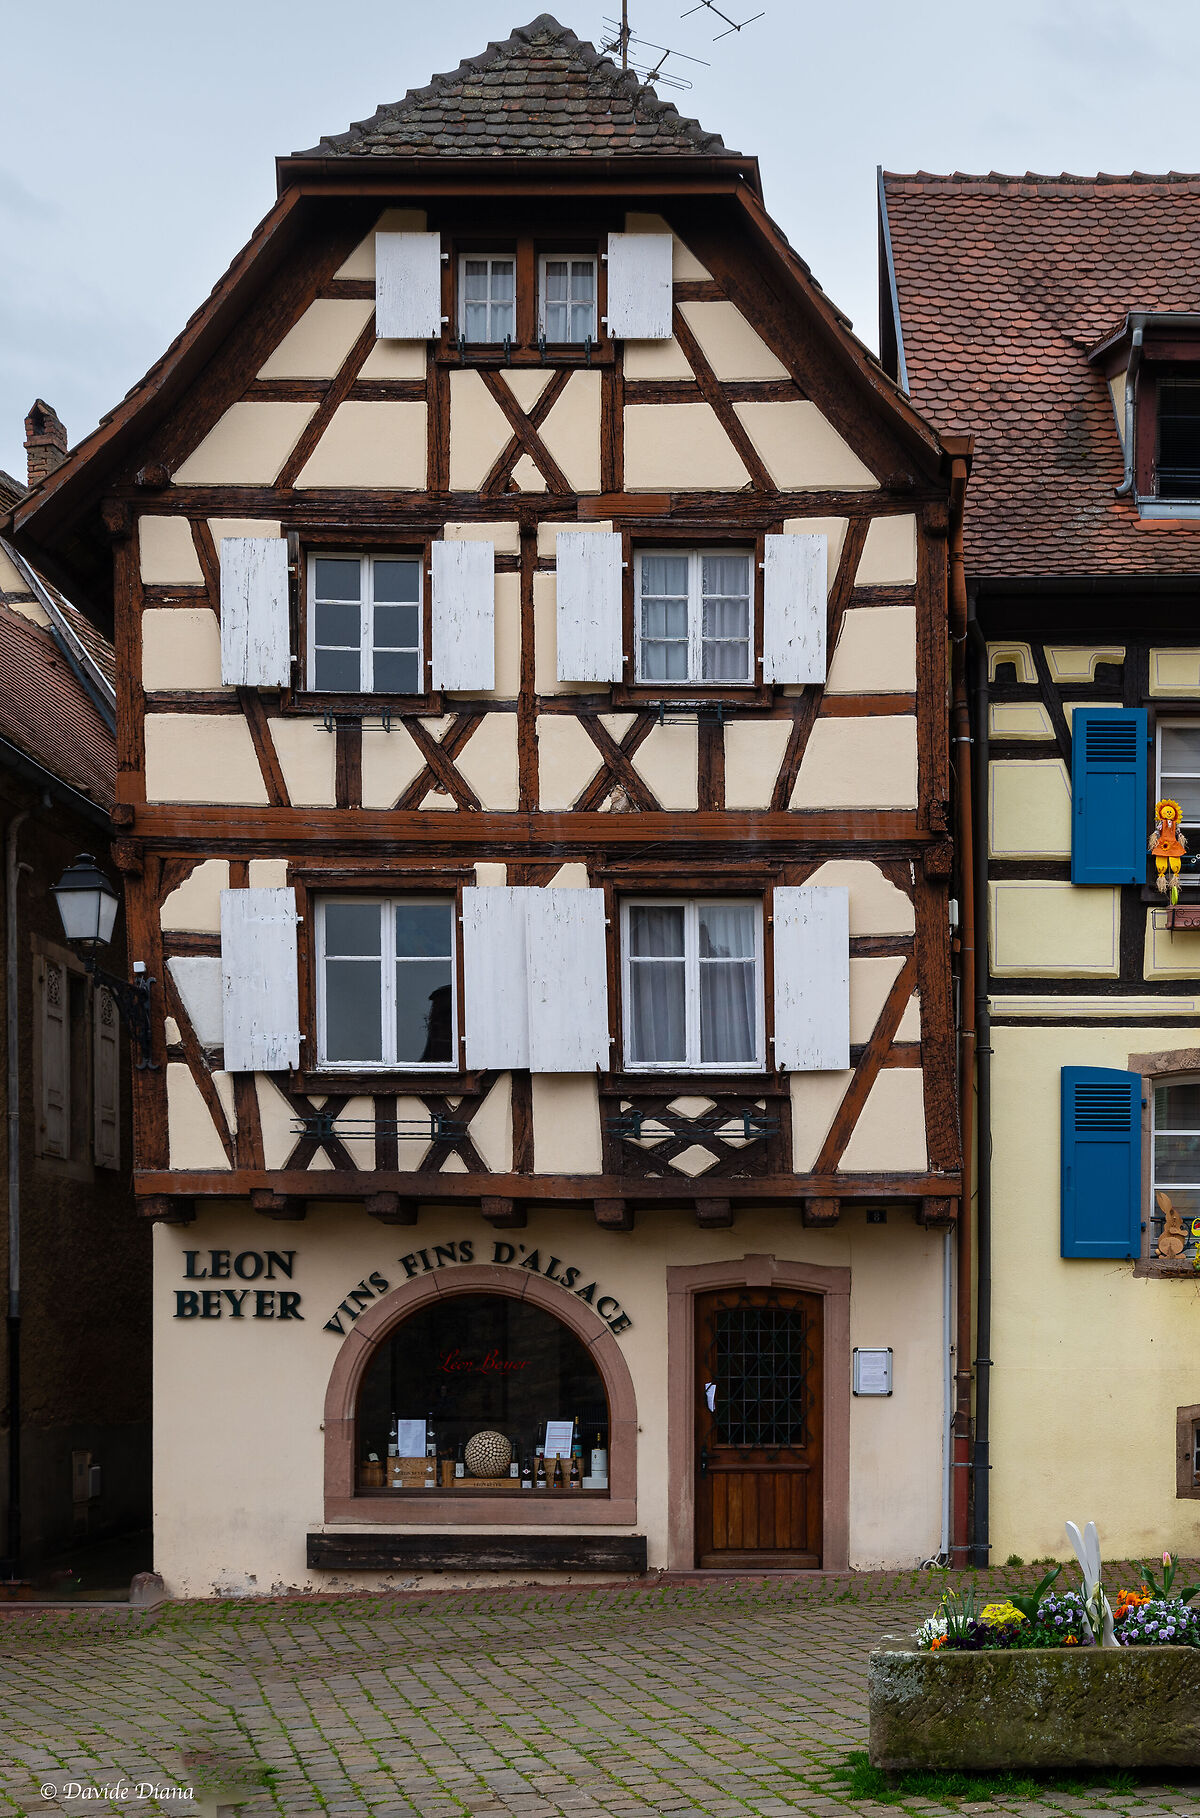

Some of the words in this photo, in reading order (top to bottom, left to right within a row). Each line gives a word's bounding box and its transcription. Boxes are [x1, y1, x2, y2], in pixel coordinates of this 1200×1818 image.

[182, 1250, 297, 1280] LEON
[322, 1270, 390, 1337] VINS
[397, 1240, 474, 1278] FINS
[491, 1241, 633, 1336] D'ALSACE
[173, 1289, 305, 1320] BEYER
